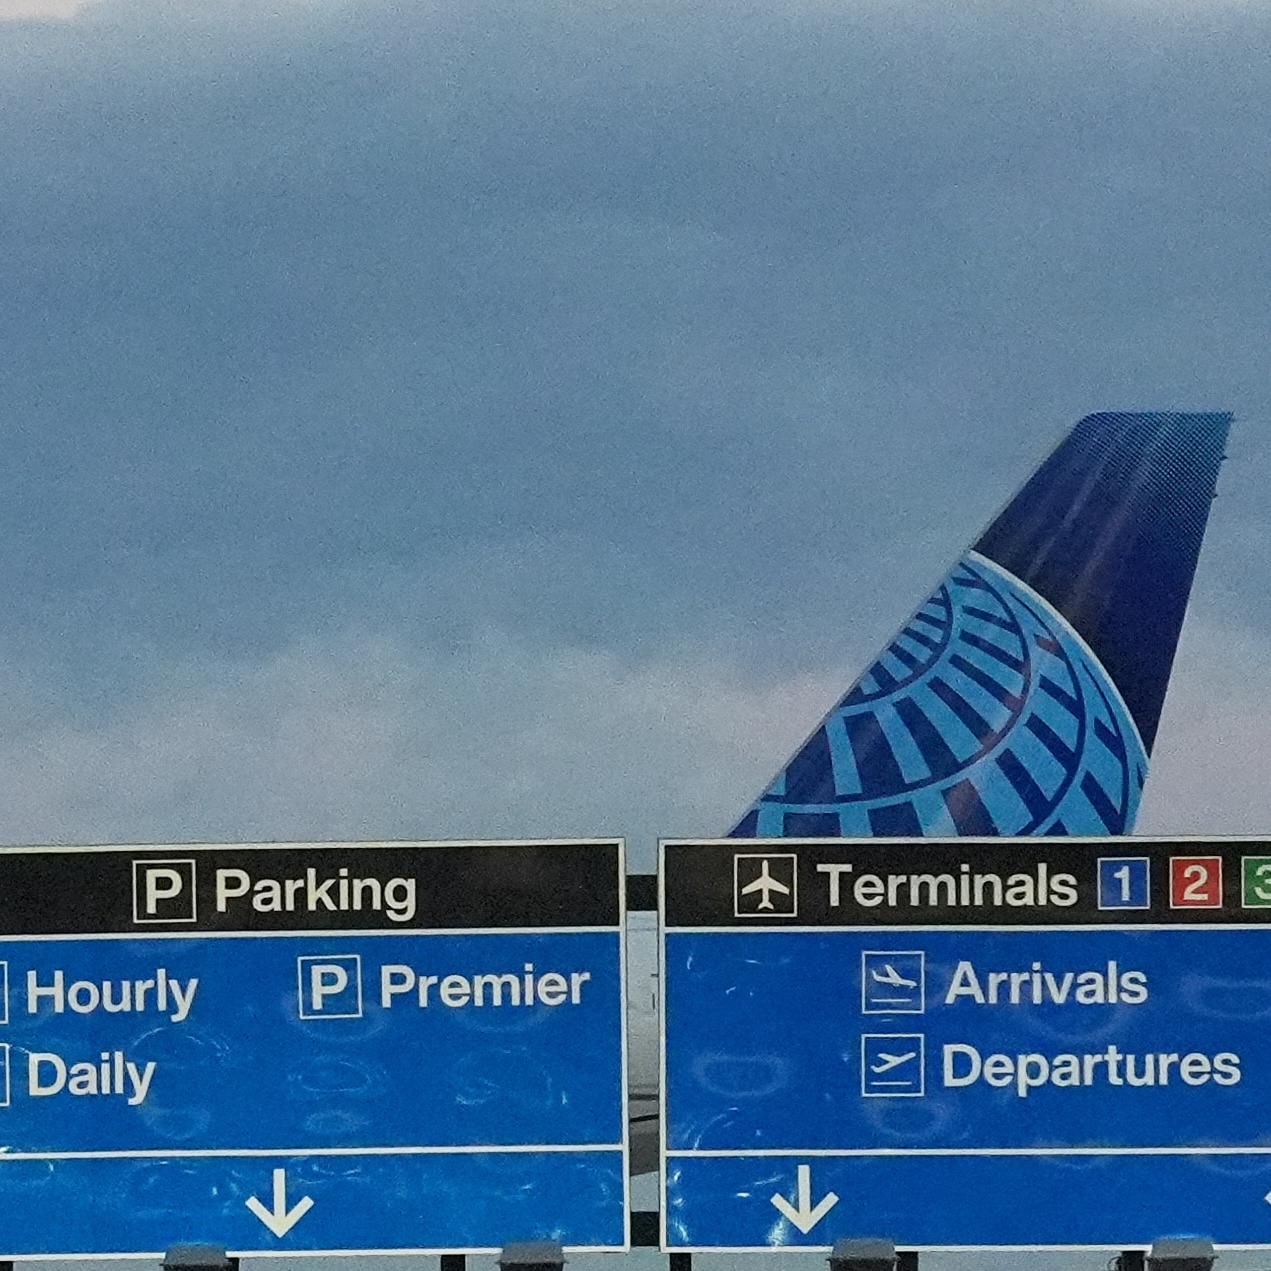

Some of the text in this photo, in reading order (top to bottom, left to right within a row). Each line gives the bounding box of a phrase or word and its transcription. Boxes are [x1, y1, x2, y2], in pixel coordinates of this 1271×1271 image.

[145, 867, 416, 921] P Parking
[816, 862, 1078, 906] Terminals
[1113, 865, 1130, 901] 1
[1183, 865, 1208, 900] 2
[27, 969, 199, 1022] Hourly
[311, 963, 591, 1010] P Premier
[945, 961, 1148, 1005] Arrivals
[25, 1050, 156, 1105] Daily
[943, 1043, 1241, 1097] Departures
